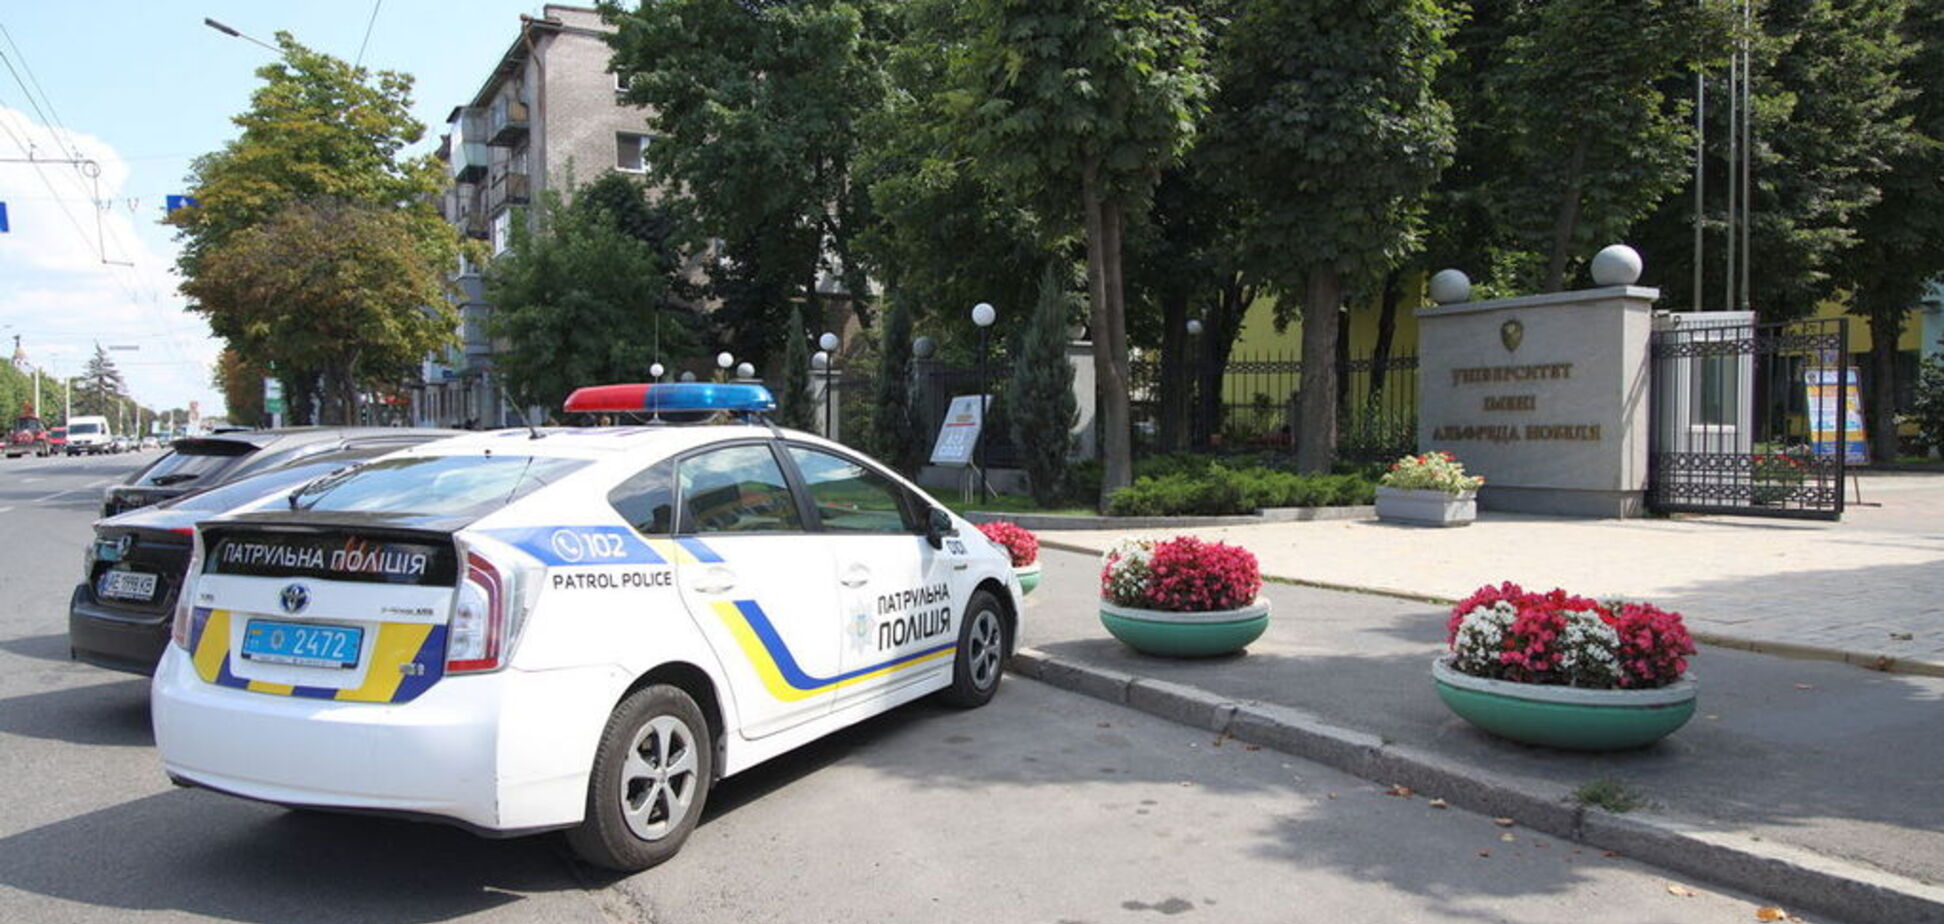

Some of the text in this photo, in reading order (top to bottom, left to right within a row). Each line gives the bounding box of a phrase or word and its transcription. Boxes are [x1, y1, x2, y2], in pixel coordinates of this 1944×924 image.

[223, 543, 427, 574] ПАТРУЛЬНА ПОЛІЦІЯ
[582, 533, 627, 558] 102
[553, 571, 672, 589] PATROL POLICE
[877, 582, 950, 615] ПАТРУЛЬНА
[293, 629, 347, 658] 2472
[878, 607, 951, 651] ПОЛІЦІЯ
